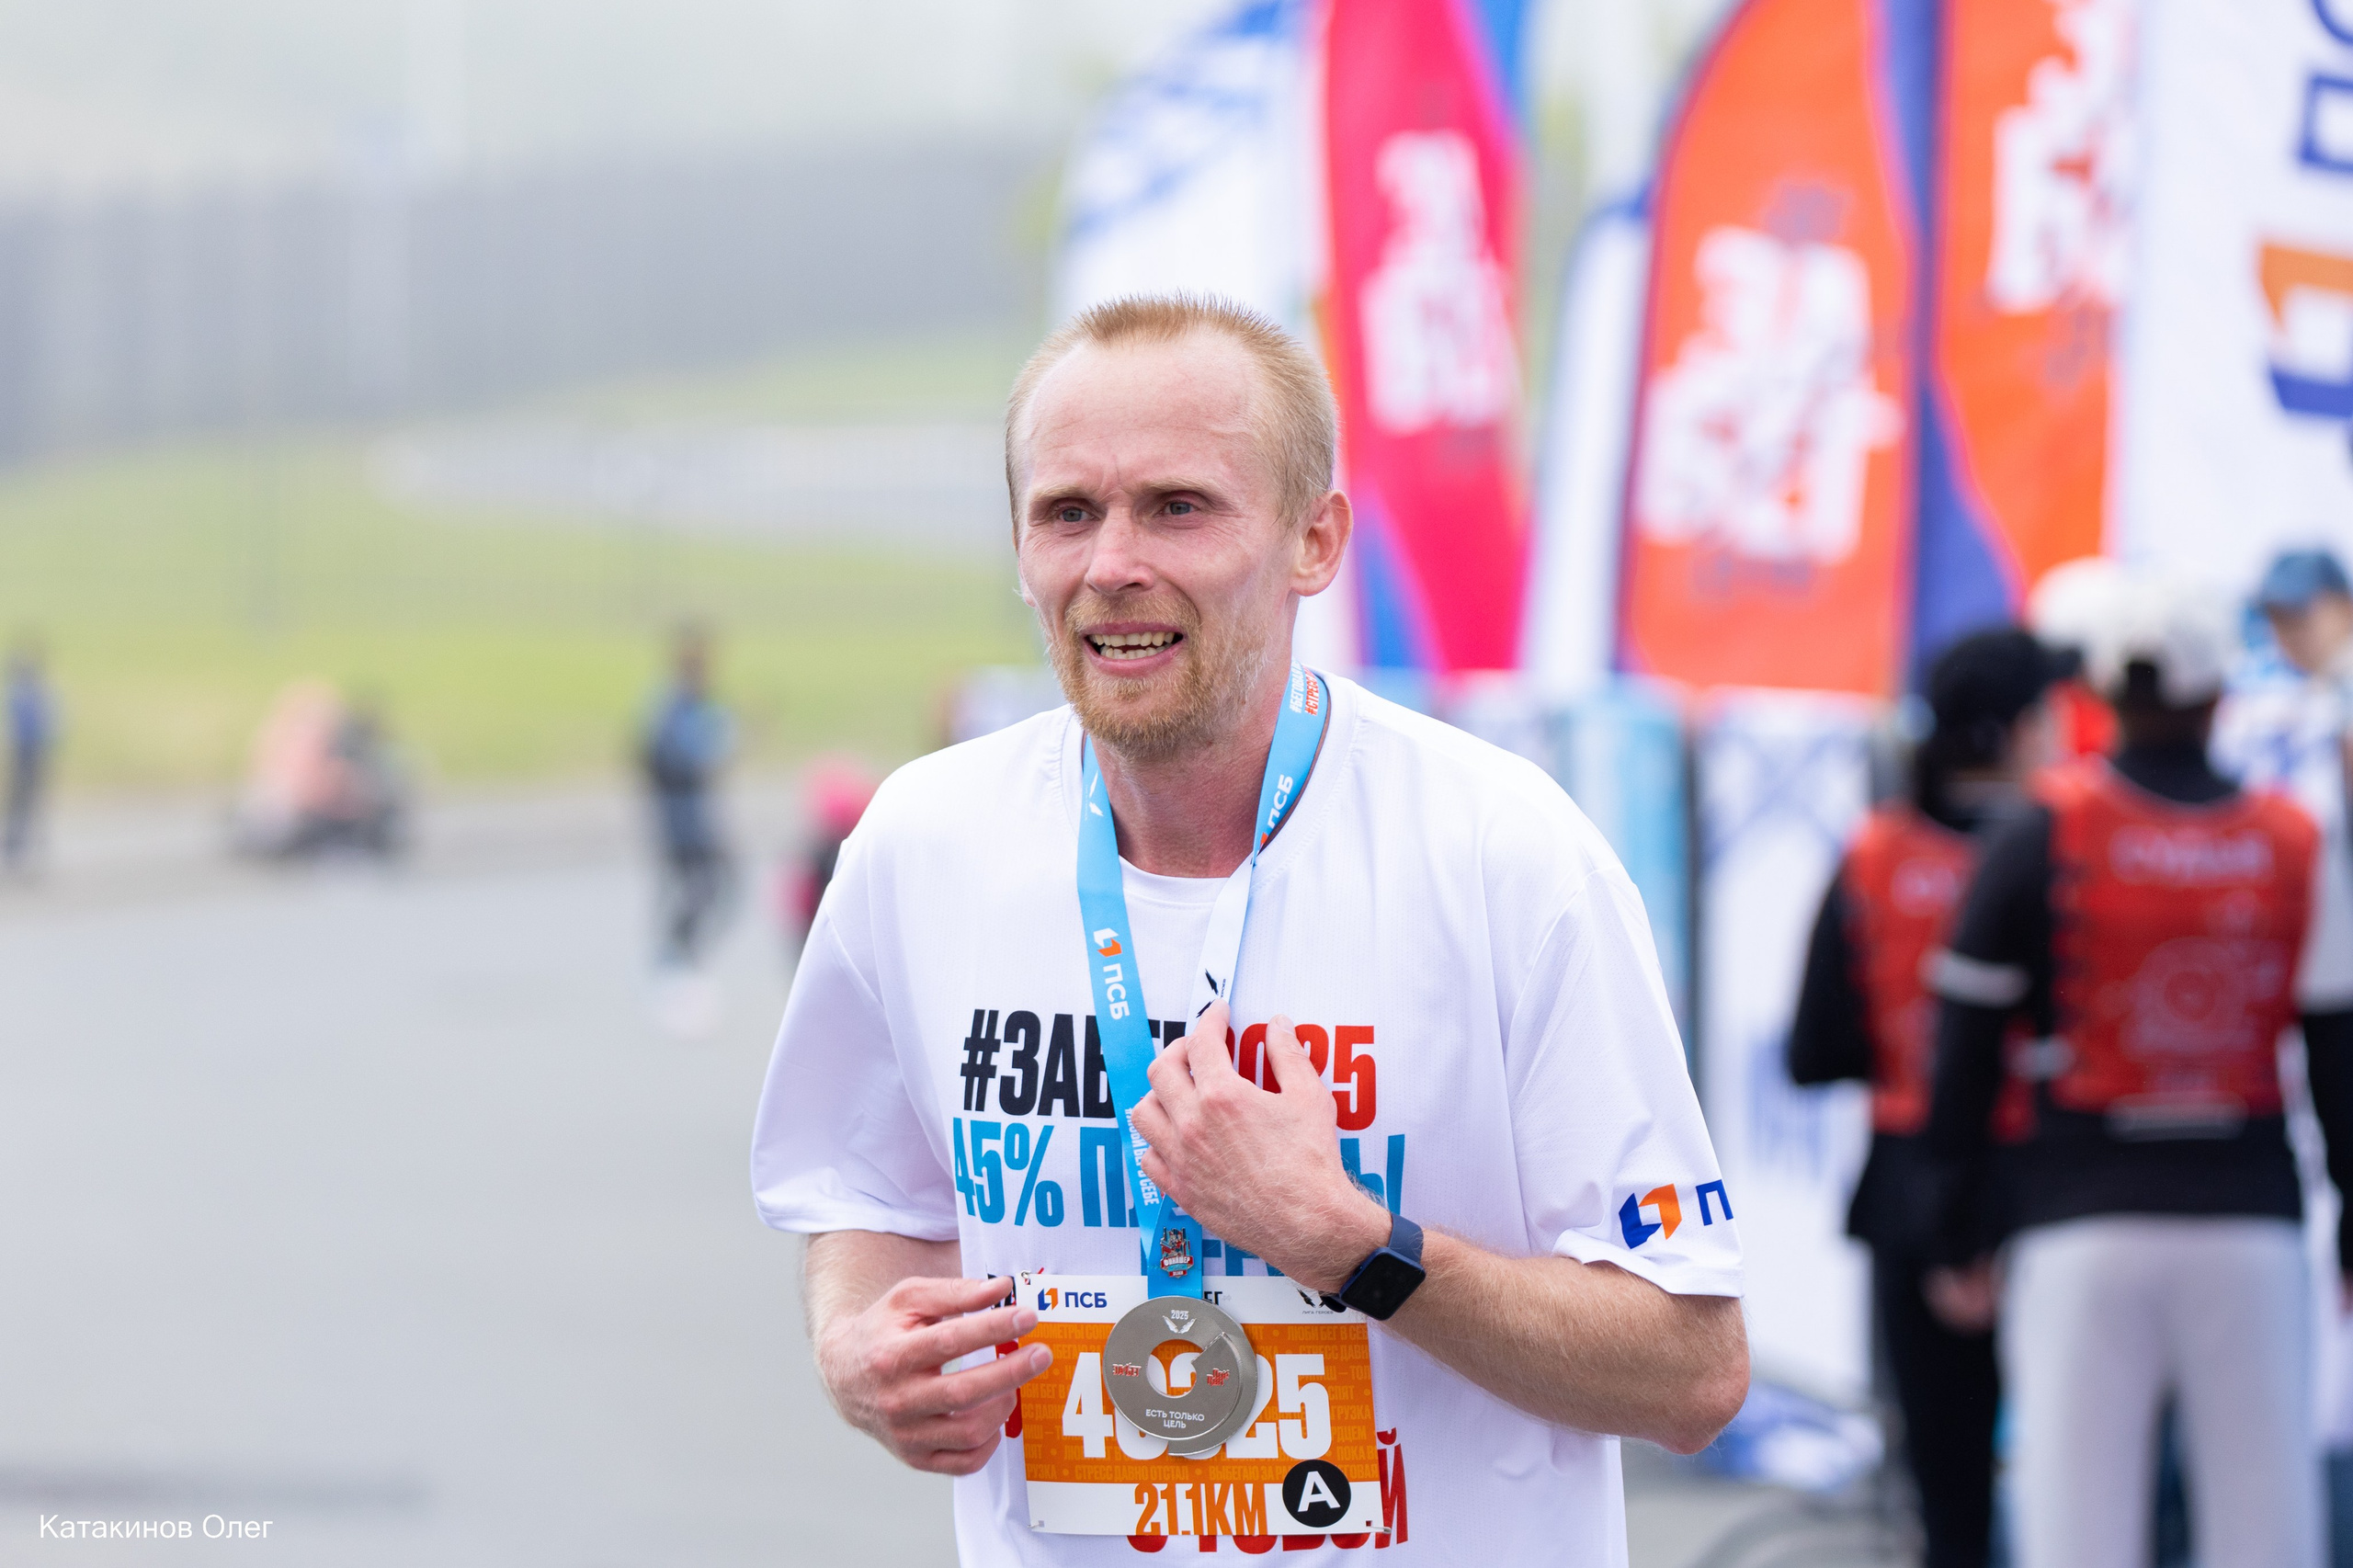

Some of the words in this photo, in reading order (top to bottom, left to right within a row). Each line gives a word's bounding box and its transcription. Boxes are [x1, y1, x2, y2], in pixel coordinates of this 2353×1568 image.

[1267, 774, 1293, 829] ПСБ
[1103, 962, 1131, 1020] ПСБ
[952, 1117, 1065, 1228] 45%
[1064, 1291, 1108, 1309] ПСБ
[1170, 1309, 1189, 1321] 2025
[1339, 1345, 1370, 1361] ДАВН
[1145, 1408, 1167, 1418] ЕСТЬ
[1168, 1410, 1205, 1422] ТОЛЬКО
[1331, 1404, 1371, 1420] ГРУЗКА
[1163, 1419, 1187, 1429] ЦЕЛЬ
[1331, 1426, 1367, 1442] РДЦЕМ
[1074, 1464, 1113, 1481] СТРЕСС
[1113, 1465, 1149, 1482] ДАВНО
[1150, 1465, 1189, 1481] ОТСТАЛ
[1297, 1471, 1341, 1513] А
